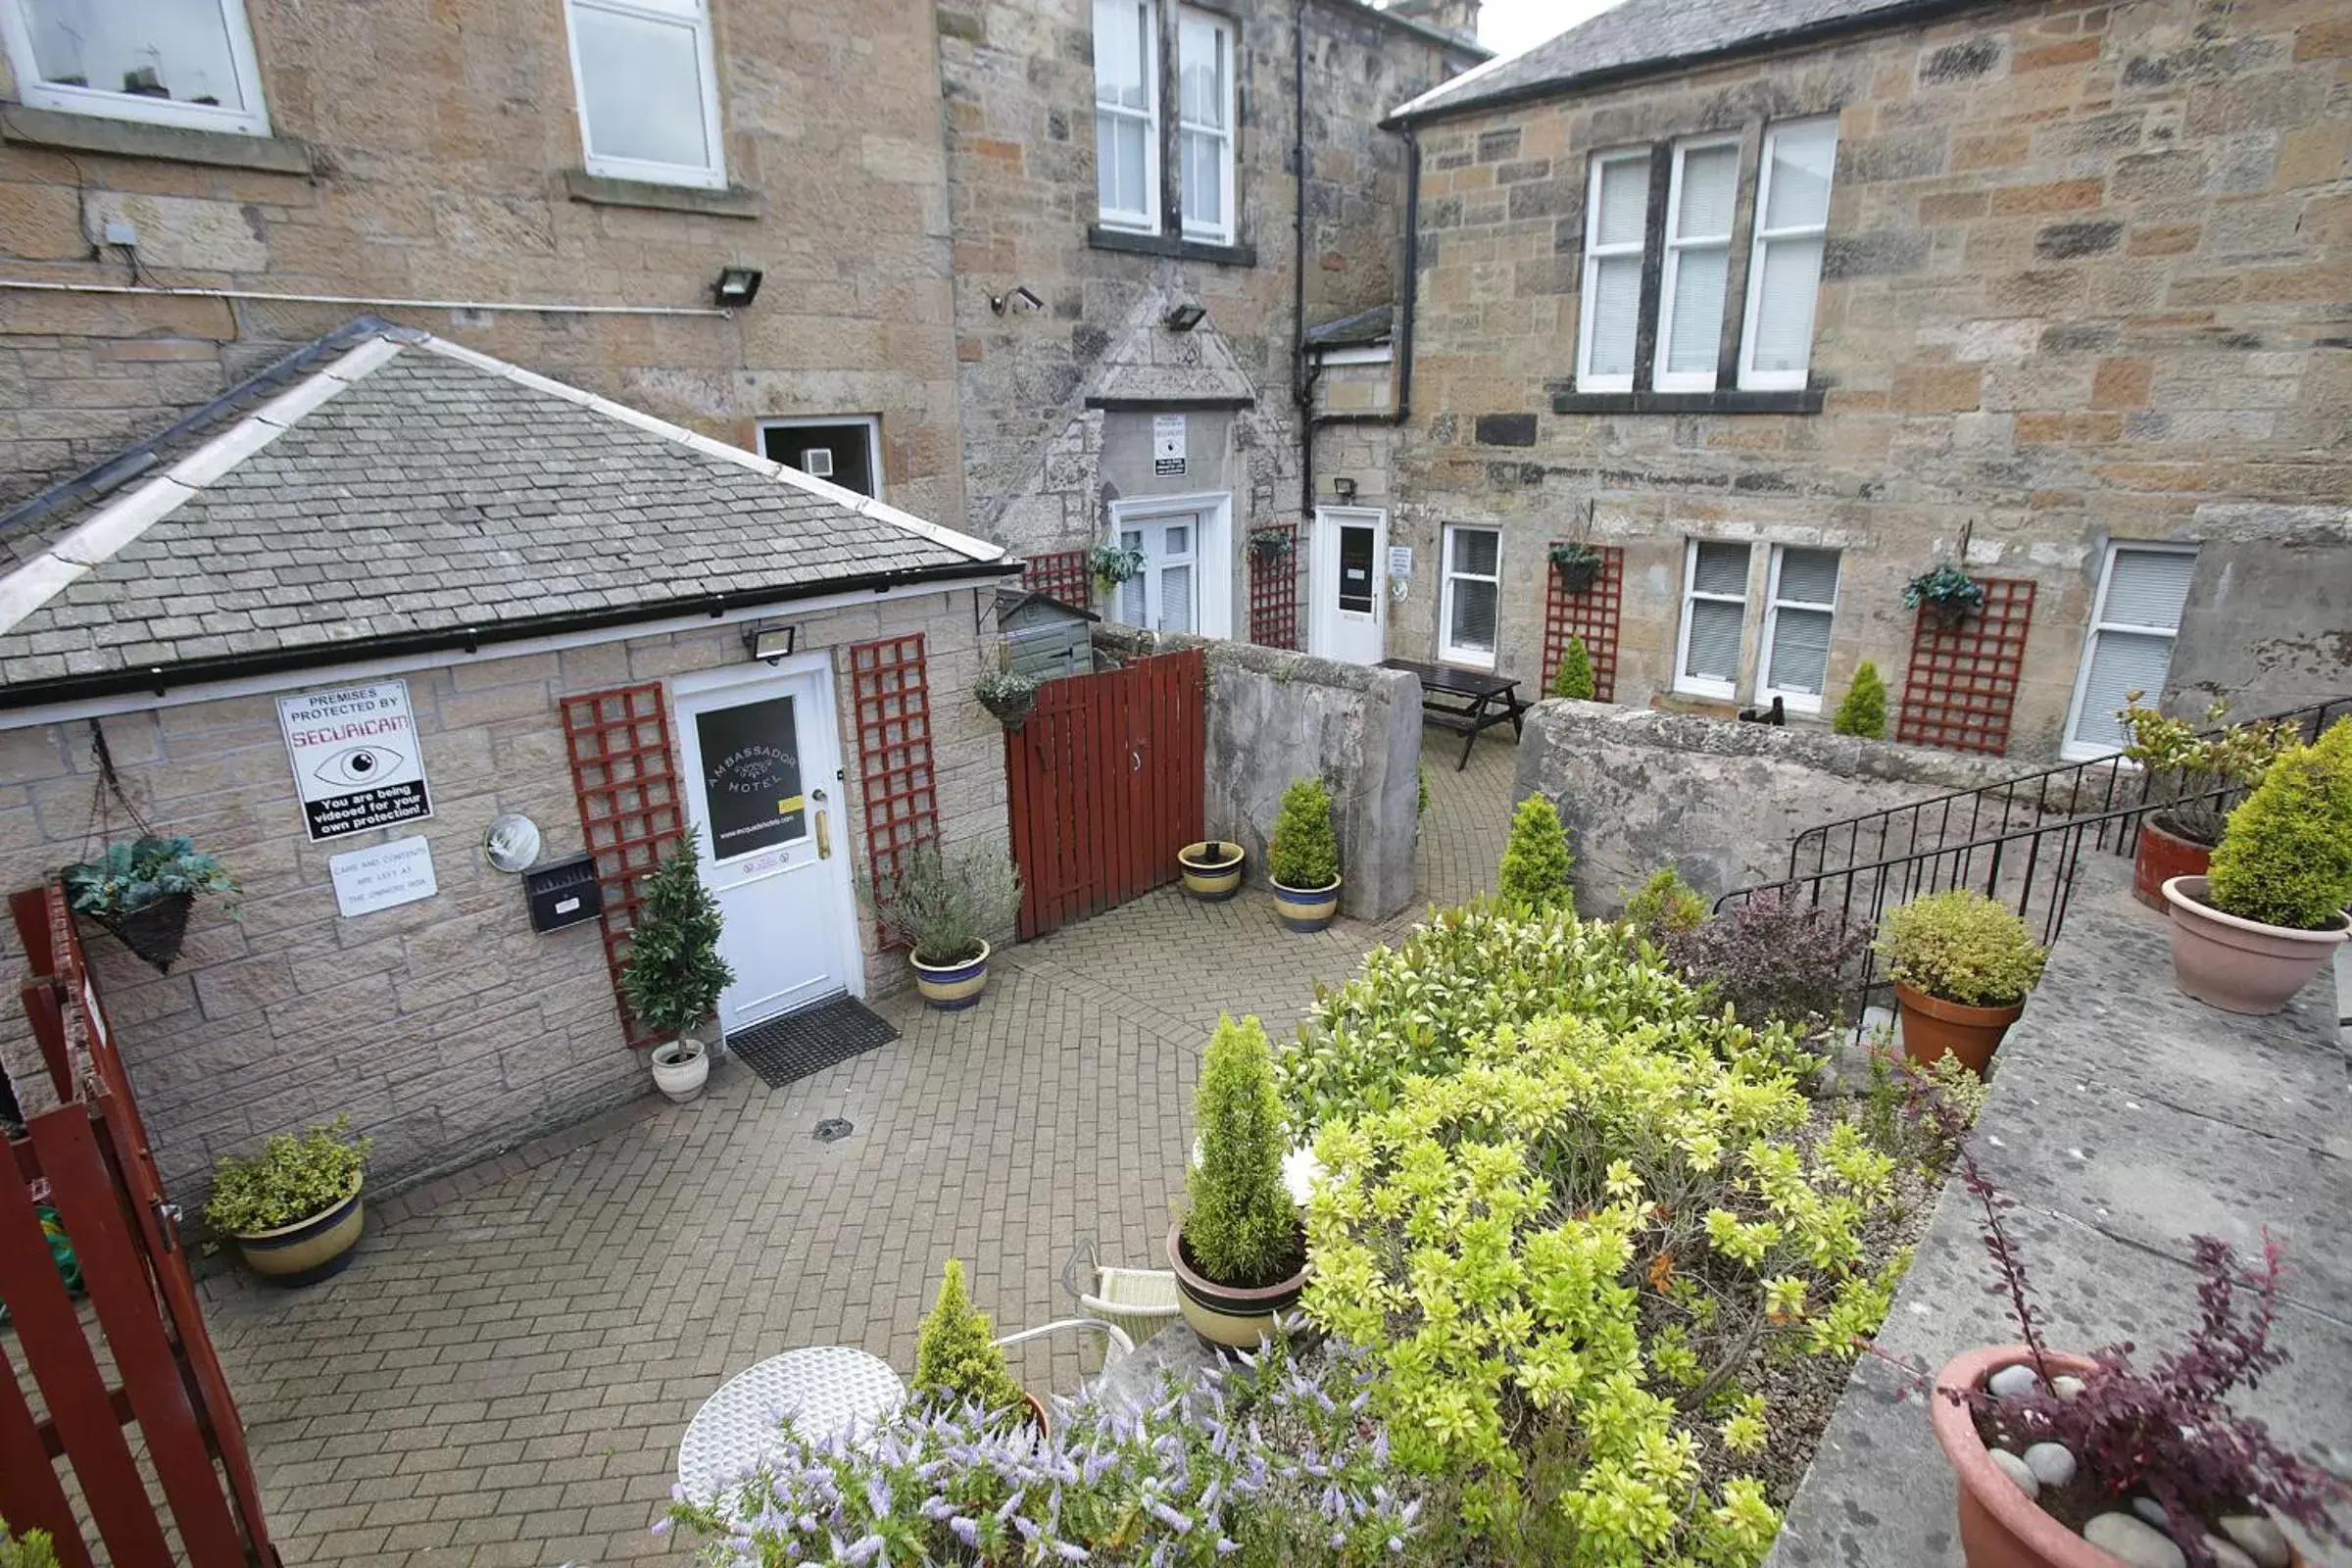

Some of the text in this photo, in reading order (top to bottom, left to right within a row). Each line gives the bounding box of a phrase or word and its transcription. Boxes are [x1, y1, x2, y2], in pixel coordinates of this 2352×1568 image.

[291, 697, 398, 722] PROTECTED BY
[309, 688, 377, 707] PREMISES
[708, 745, 797, 789] AMBASSADOR
[728, 774, 782, 794] HOTEL
[314, 794, 421, 824] videoed for your
[320, 785, 412, 810] You are being
[320, 804, 420, 834] own protection!
